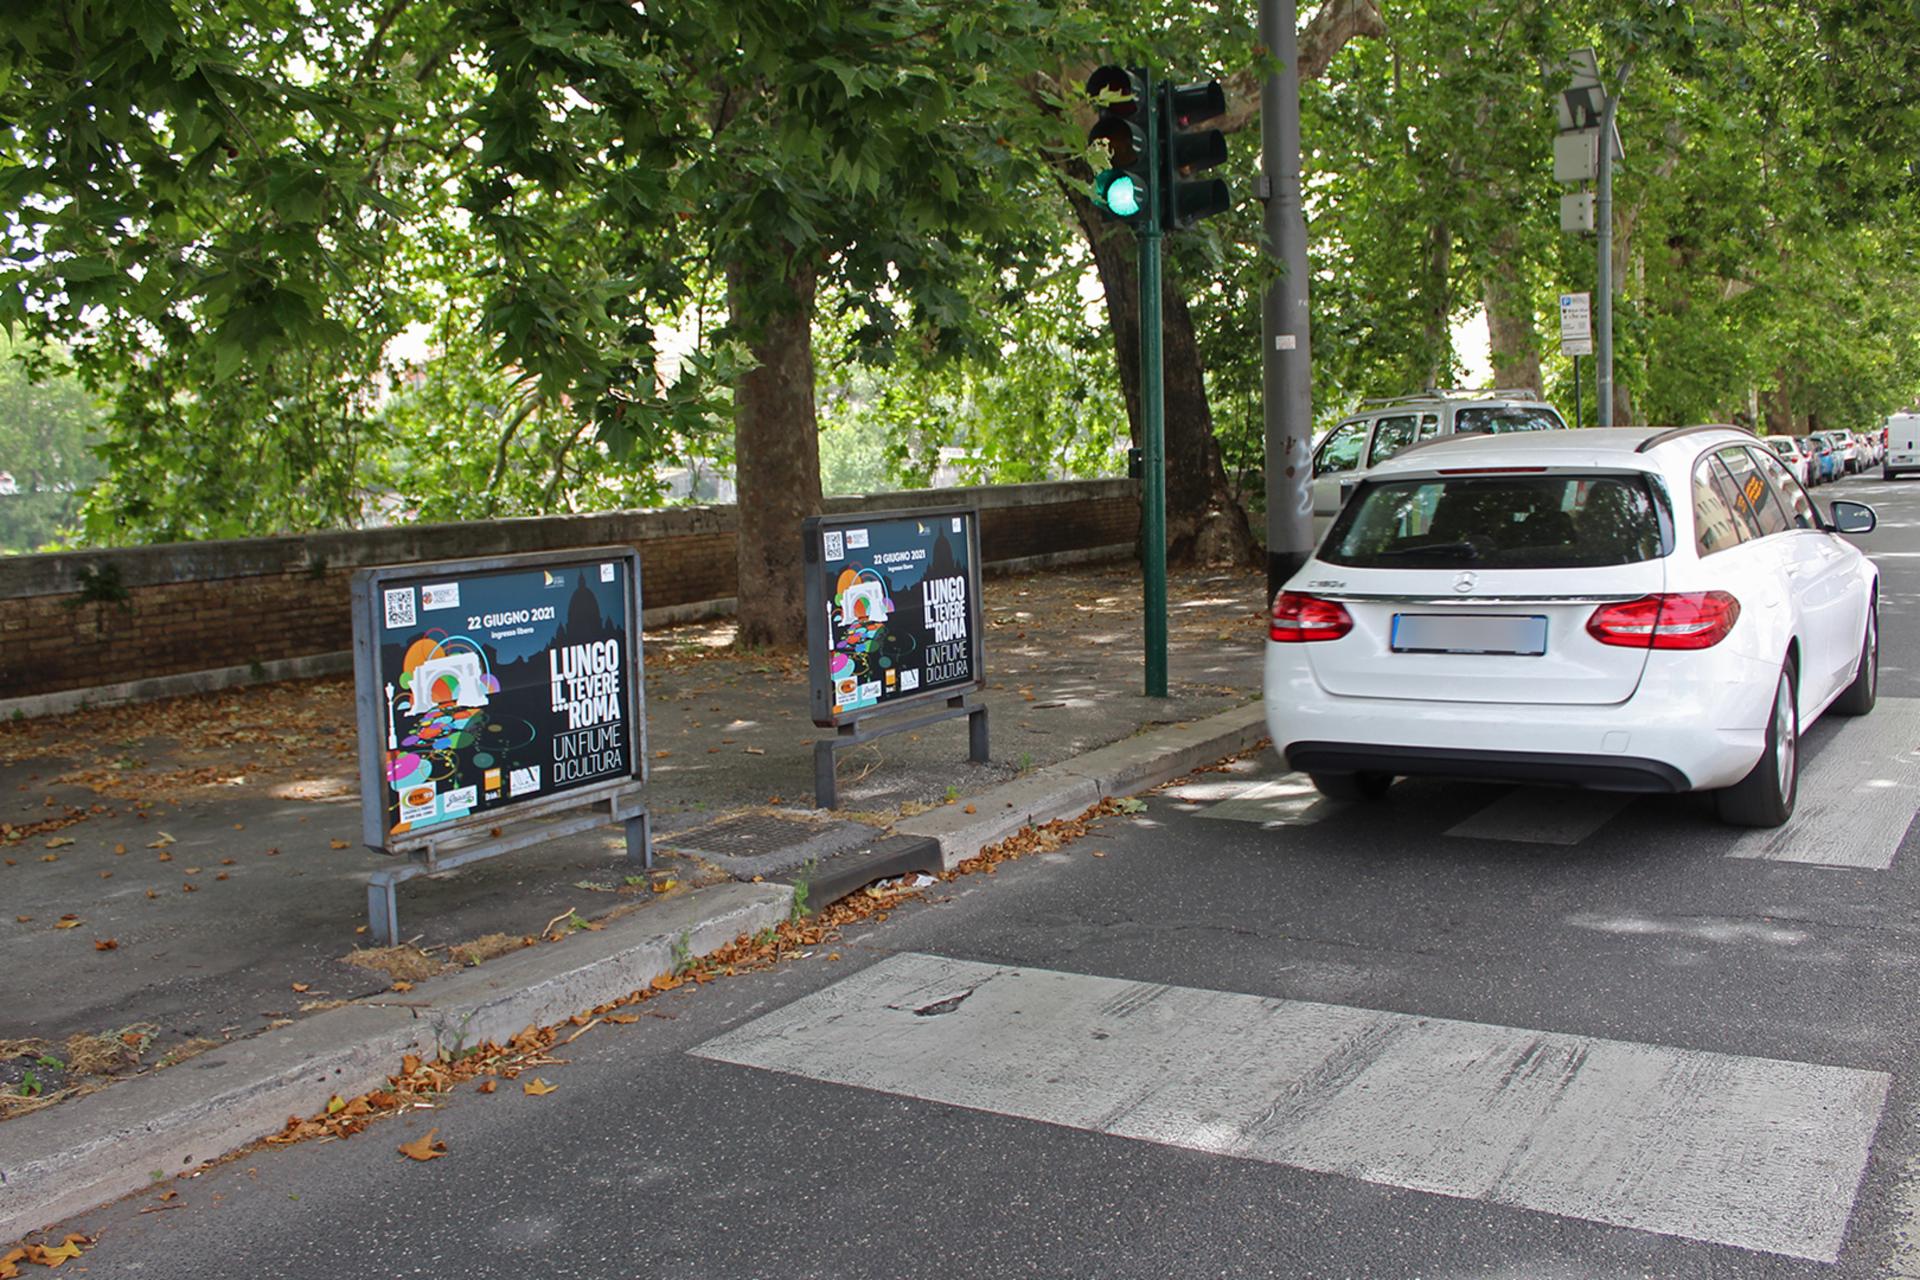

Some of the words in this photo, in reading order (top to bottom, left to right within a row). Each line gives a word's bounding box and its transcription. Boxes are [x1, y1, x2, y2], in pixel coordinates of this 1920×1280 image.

[873, 554, 882, 565] 22
[883, 551, 911, 564] GIUGNO
[911, 549, 926, 560] 2021
[923, 576, 966, 606] LUNGO
[467, 616, 482, 631] 22
[483, 610, 530, 628] GIUGNO
[531, 606, 556, 622] 2021
[924, 605, 934, 623] IL
[934, 600, 966, 622] TEVERE
[550, 639, 620, 682] LUNGO
[926, 646, 941, 666] UN
[941, 640, 968, 663] FIUME
[926, 667, 934, 683] DI
[934, 659, 969, 681] CULTURA
[551, 681, 567, 705] IL
[567, 670, 620, 702] TEVERE
[553, 734, 577, 761] UN
[578, 723, 622, 756] FIUME
[553, 762, 566, 783] DI
[567, 749, 622, 779] CULTURA
